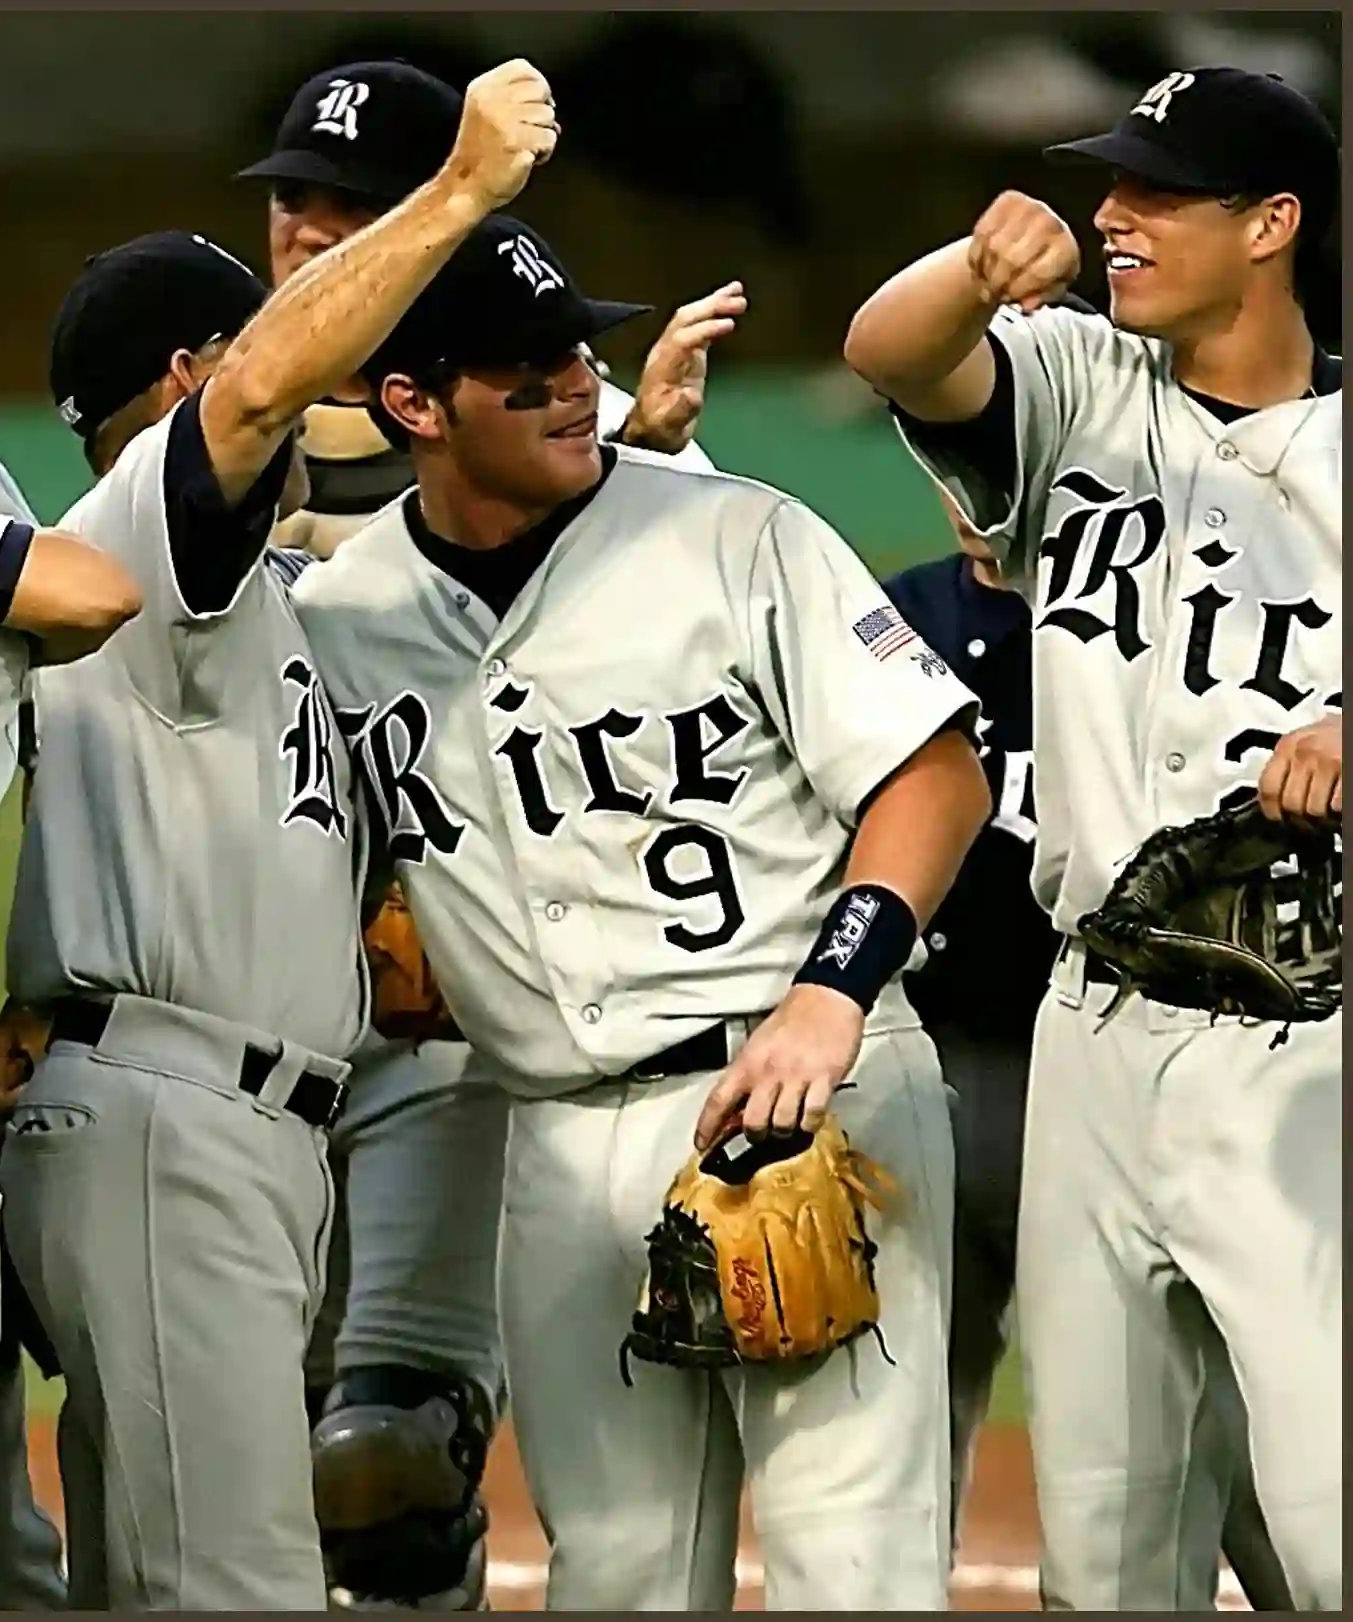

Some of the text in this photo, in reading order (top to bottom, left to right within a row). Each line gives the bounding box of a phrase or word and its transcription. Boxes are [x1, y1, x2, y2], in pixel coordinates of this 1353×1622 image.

[310, 79, 371, 142] R
[1129, 71, 1197, 124] R
[496, 233, 566, 299] R
[1034, 465, 1342, 712] Ric
[334, 677, 753, 867] Rice
[641, 821, 747, 955] 9
[815, 893, 881, 972] TPX
